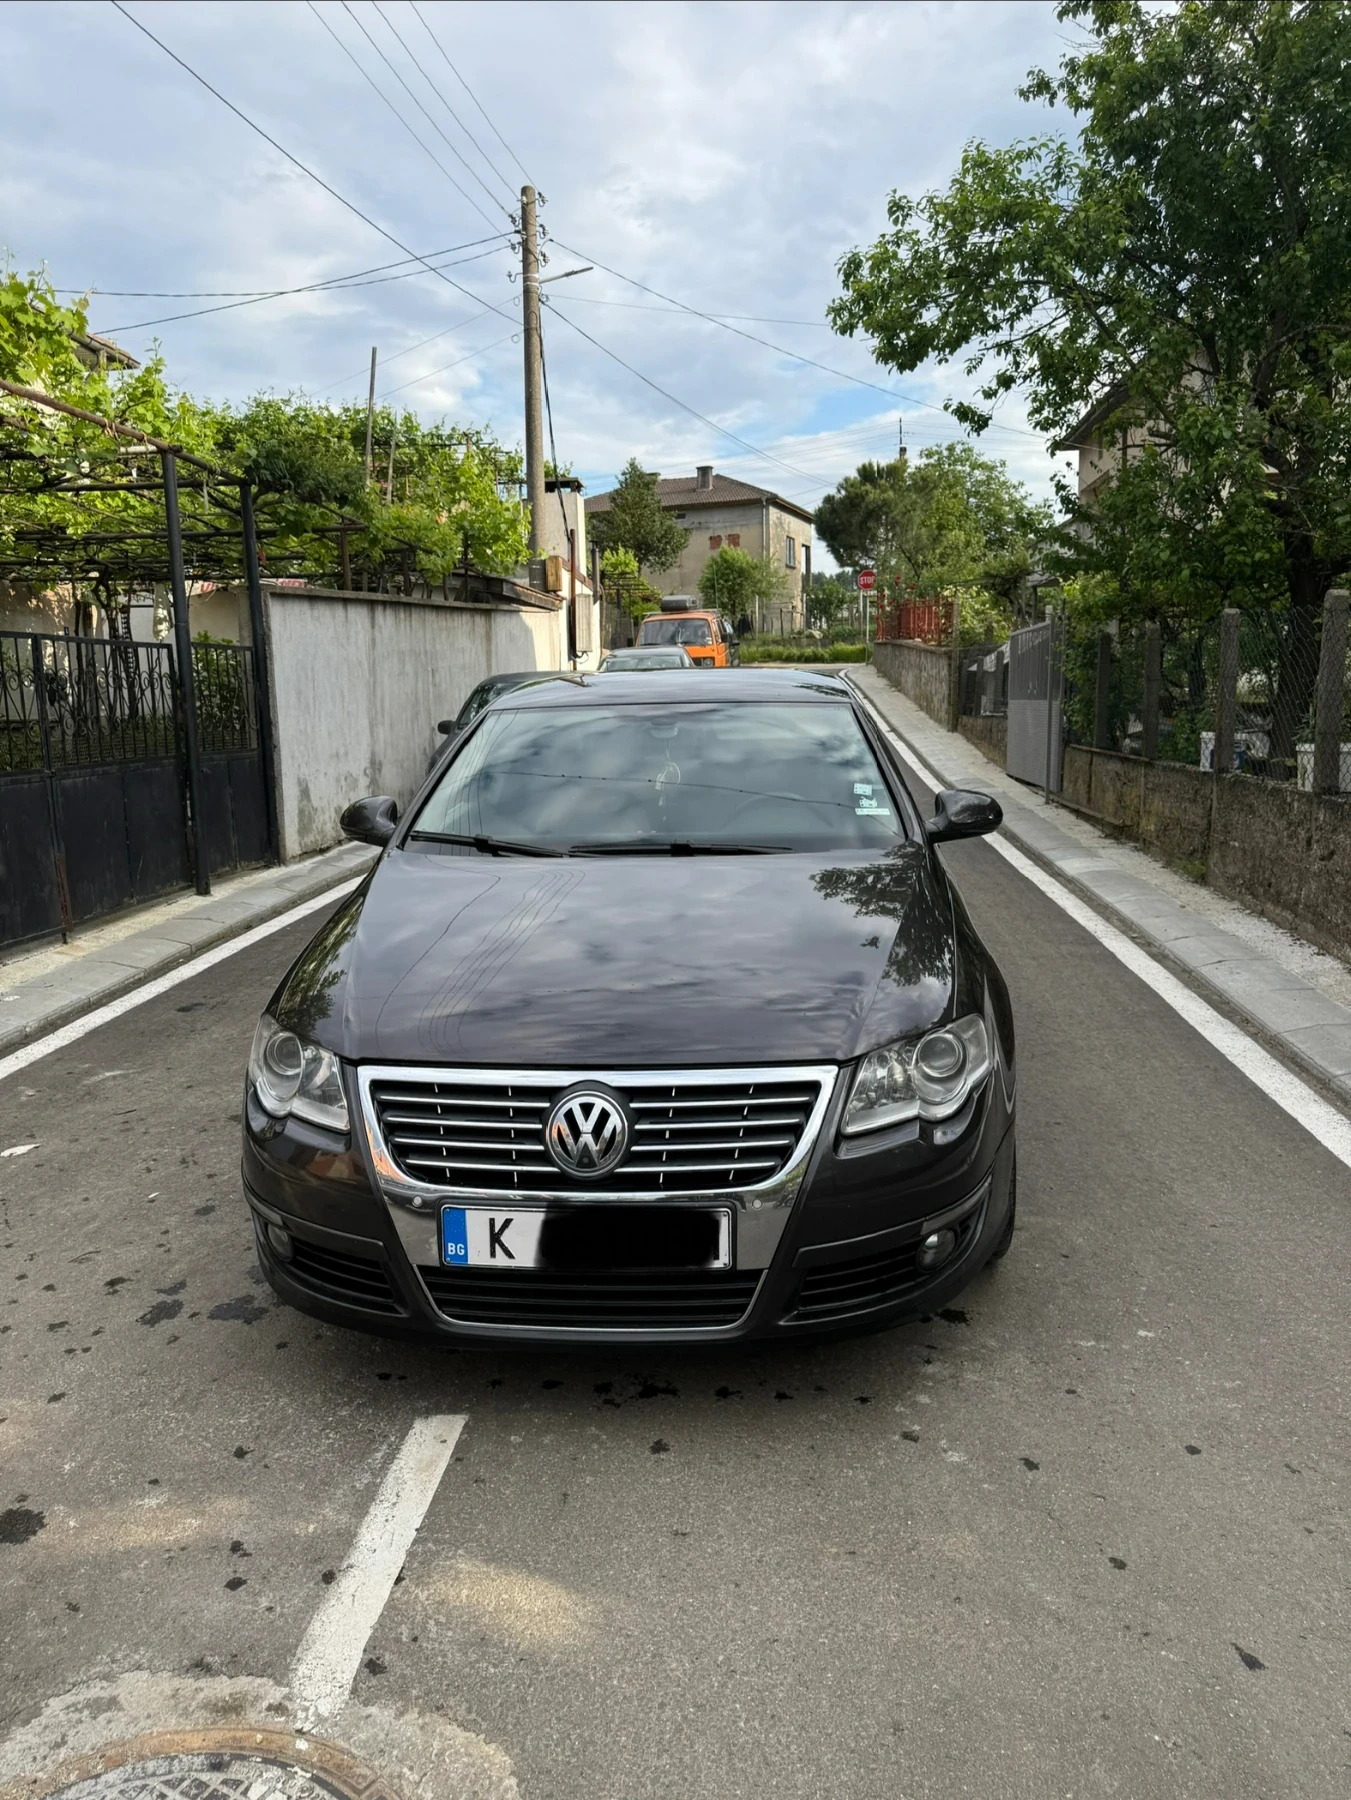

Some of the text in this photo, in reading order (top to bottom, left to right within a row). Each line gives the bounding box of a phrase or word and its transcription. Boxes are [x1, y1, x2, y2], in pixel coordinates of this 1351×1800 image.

[860, 576, 876, 584] STOP
[551, 1096, 623, 1172] VW
[447, 1242, 465, 1256] BG
[488, 1217, 516, 1260] K
